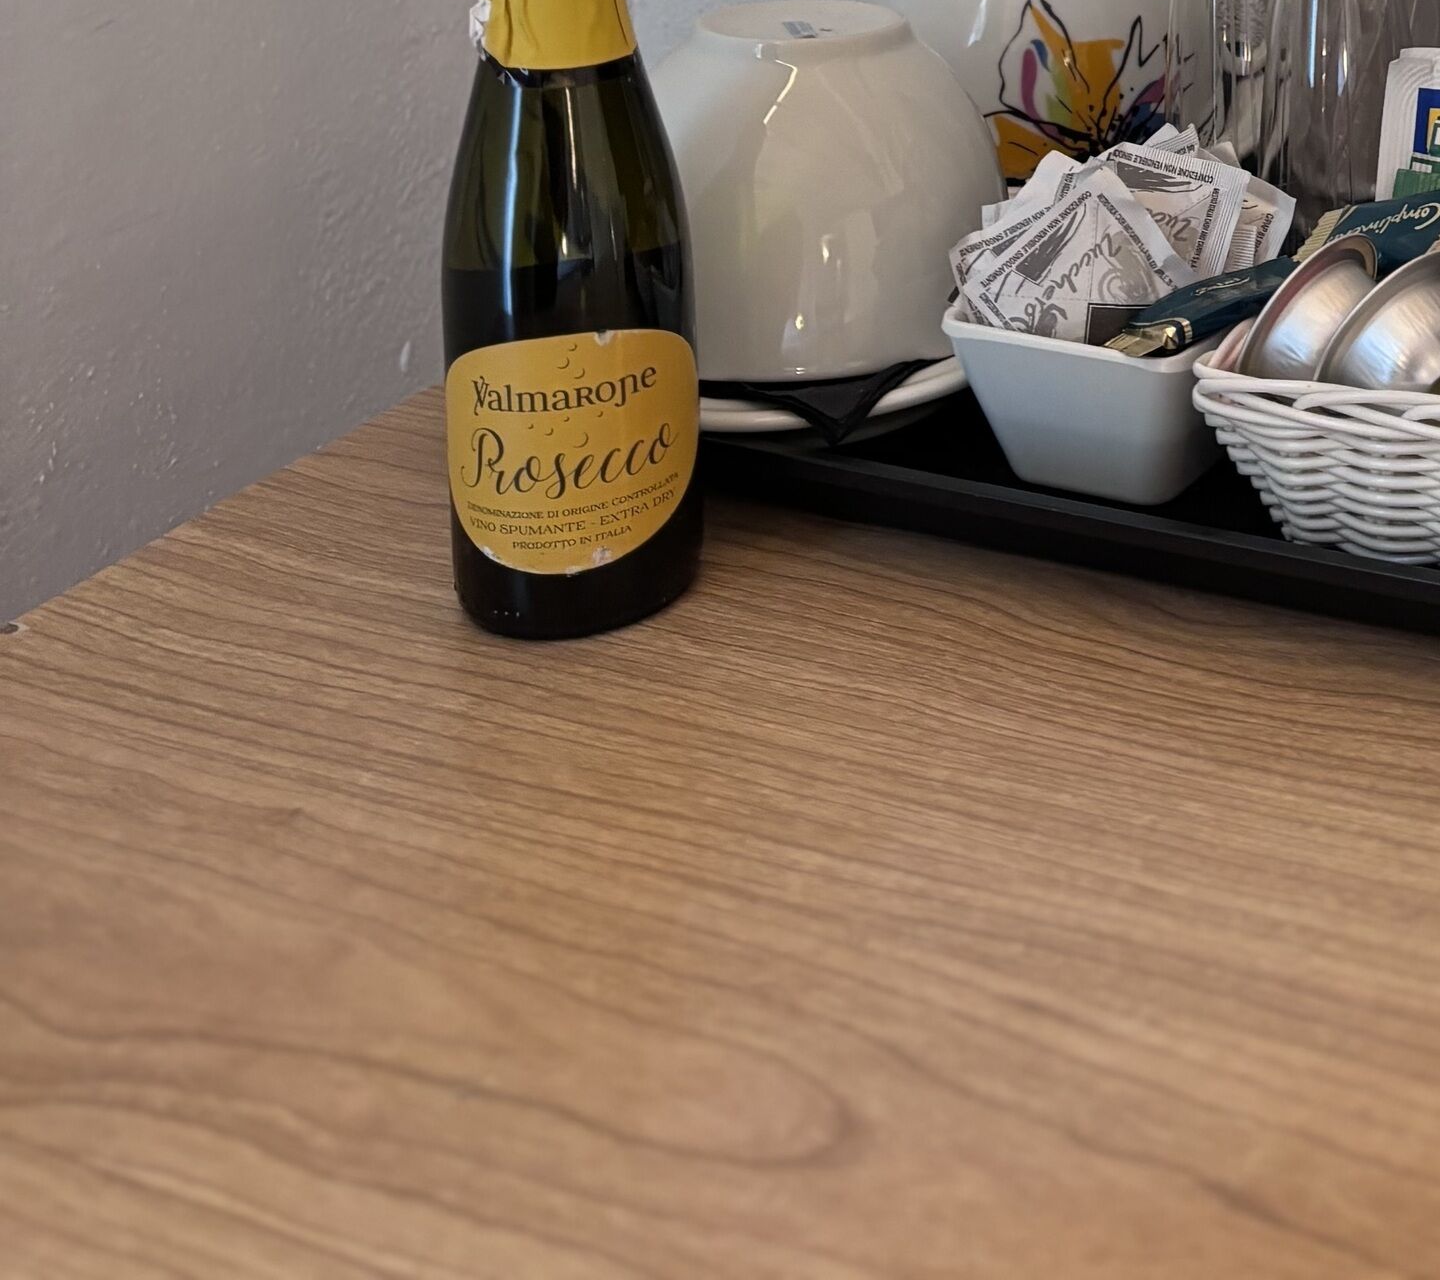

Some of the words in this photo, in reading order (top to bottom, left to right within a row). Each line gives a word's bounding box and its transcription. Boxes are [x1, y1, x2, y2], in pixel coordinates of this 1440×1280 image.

[1058, 190, 1093, 221] CONFEZIONE
[1020, 226, 1051, 254] VENDIBILE
[1046, 217, 1062, 232] NON
[979, 249, 1024, 289] SINGOLARMENTE
[1024, 228, 1122, 317] Zucchero
[471, 366, 657, 416] Valmarone
[461, 422, 680, 500] Prosecco
[467, 501, 544, 520] DENOMINAZIONE
[547, 510, 559, 518] DI
[562, 501, 609, 518] ORIGINE
[611, 472, 680, 506] CONTROLLATA
[469, 516, 496, 532] VINO
[499, 520, 586, 536] SPUMANTE
[600, 502, 650, 526] EXTRA
[512, 538, 577, 550] PRODOTTO
[579, 534, 592, 545] IN
[595, 524, 633, 541] ITALIA
